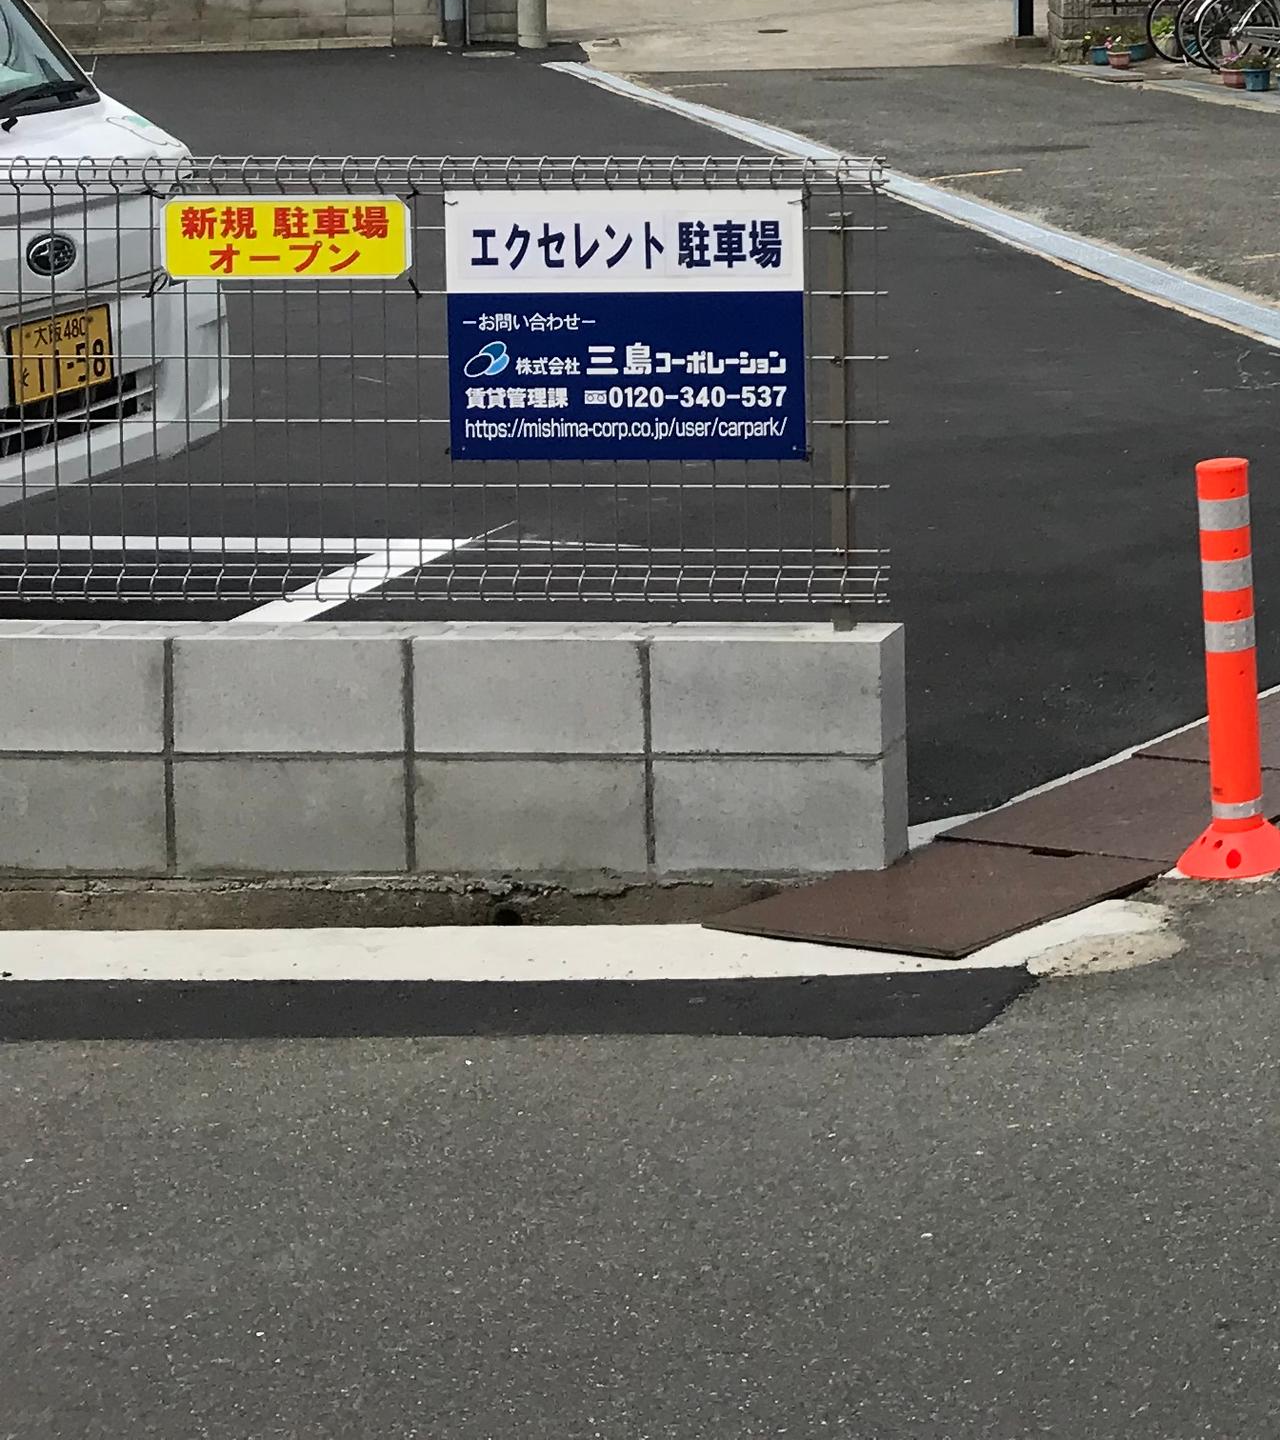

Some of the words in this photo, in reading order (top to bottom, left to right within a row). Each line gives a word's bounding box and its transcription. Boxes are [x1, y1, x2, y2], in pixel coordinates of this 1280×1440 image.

[180, 206, 258, 240] 新規
[273, 206, 389, 239] 駐車場
[208, 240, 361, 274] オープン
[471, 221, 665, 271] エクセレント
[677, 219, 783, 269] 駐車場
[515, 356, 581, 376] 株式会社
[586, 342, 787, 376] 三島コーポレーション
[464, 387, 569, 410] 賃貸管理課
[608, 386, 788, 409] 0120-340-537
[465, 416, 789, 441] https://mishima-corp.co.jp/user/carpark/
